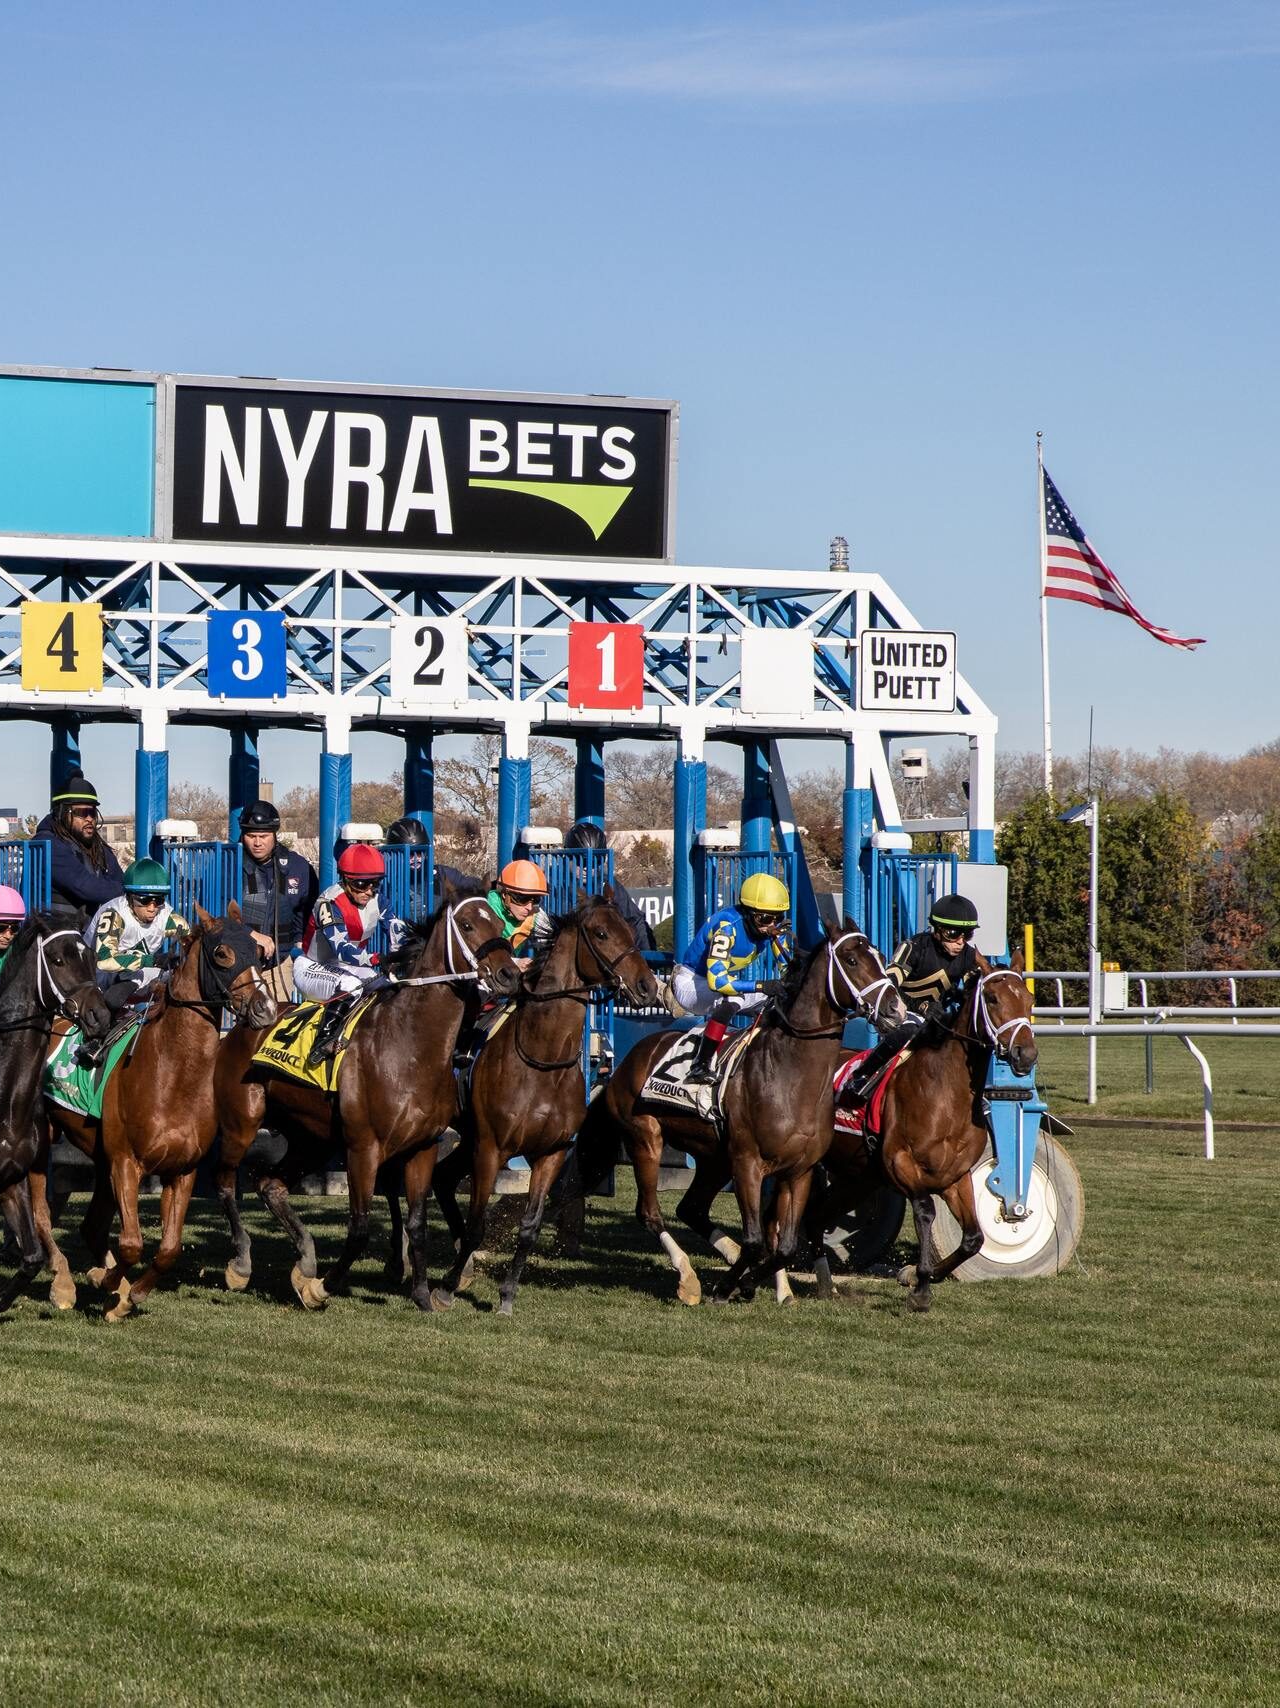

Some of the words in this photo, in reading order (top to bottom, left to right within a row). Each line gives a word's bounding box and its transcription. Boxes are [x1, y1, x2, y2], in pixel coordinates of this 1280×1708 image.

[202, 404, 453, 535] NYRA
[468, 418, 636, 481] BETS
[46, 611, 79, 673] 4
[231, 618, 264, 681] 3
[413, 625, 445, 686] 2
[595, 631, 617, 692] 1
[871, 636, 948, 668] UNITED
[873, 670, 941, 700] PUETT
[96, 911, 112, 934] 5
[320, 902, 333, 925] 4
[711, 935, 730, 959] 2
[271, 1007, 319, 1051] 4
[651, 1034, 702, 1084] 2
